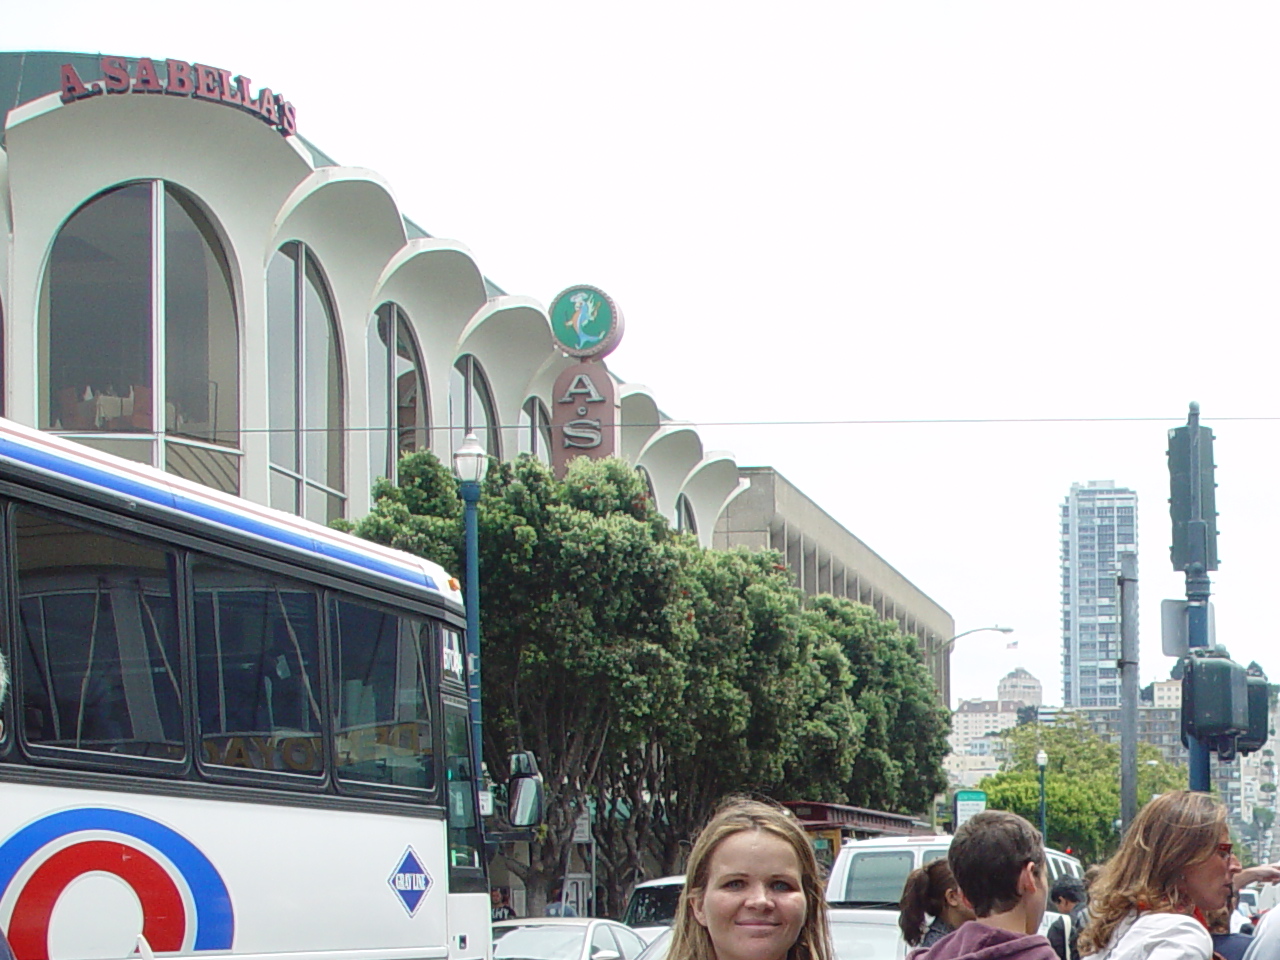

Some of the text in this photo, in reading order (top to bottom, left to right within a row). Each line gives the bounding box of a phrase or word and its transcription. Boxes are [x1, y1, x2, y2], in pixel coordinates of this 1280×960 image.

[100, 56, 296, 138] SABELLA'S
[395, 873, 426, 891] GRAY LINE
